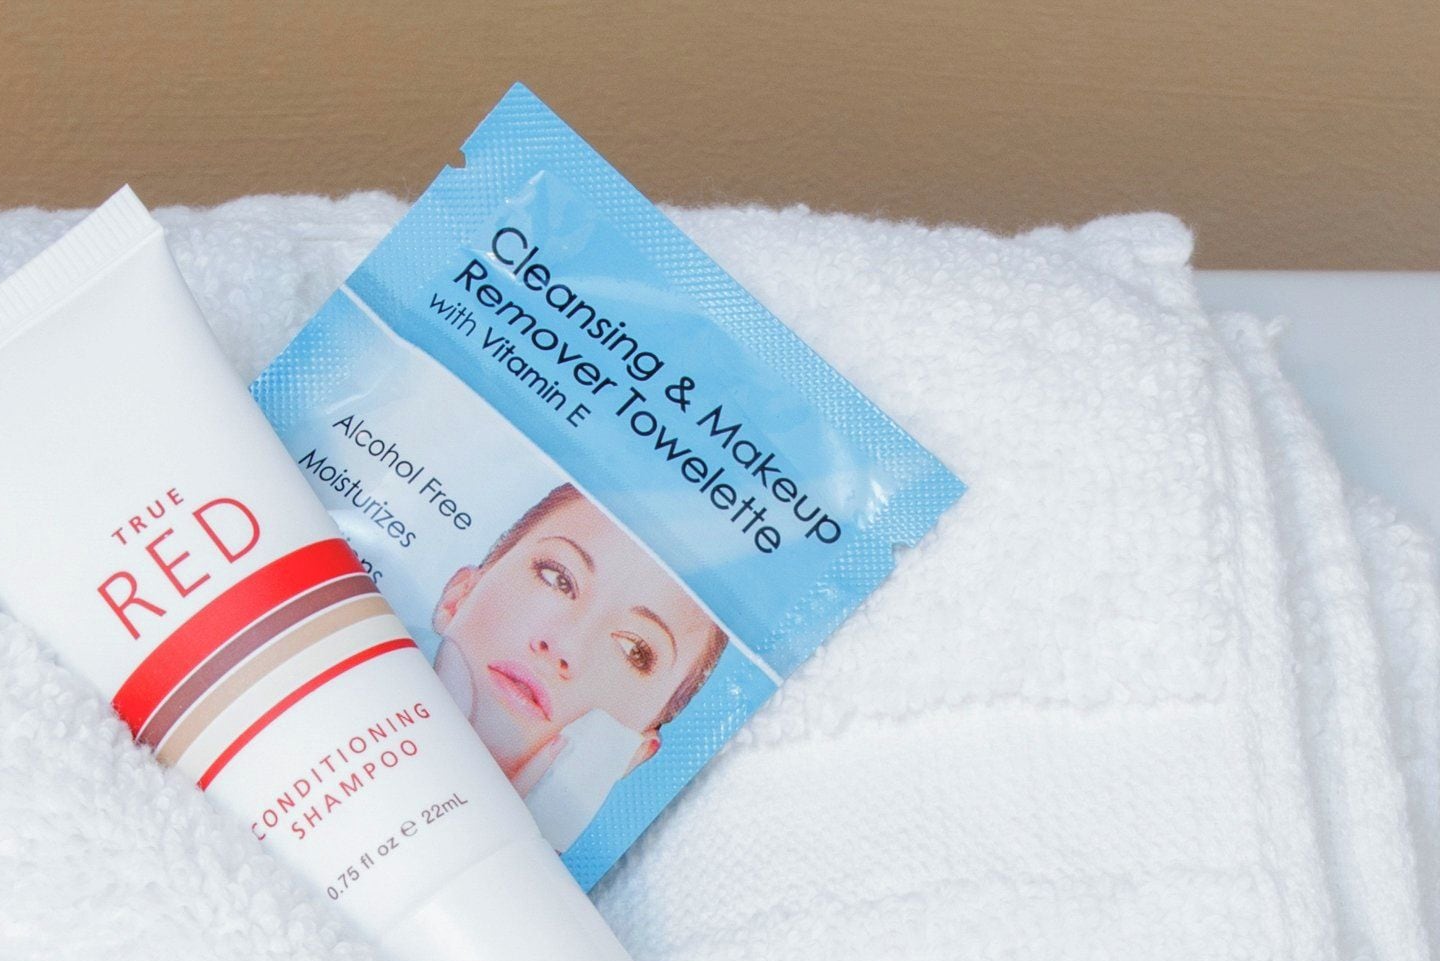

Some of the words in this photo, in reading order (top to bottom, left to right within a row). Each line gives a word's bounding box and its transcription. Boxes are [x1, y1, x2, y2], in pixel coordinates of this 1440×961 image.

[429, 292, 477, 337] with
[482, 326, 567, 411] Vitamin
[566, 403, 592, 428] E
[453, 258, 618, 395] Remover
[616, 386, 781, 554] Towelette
[491, 226, 665, 382] Cleansing
[664, 376, 695, 413] &
[696, 404, 842, 544] Makeup
[111, 487, 184, 546] TRUE
[298, 448, 417, 548] Moisturizes
[332, 414, 425, 484] Alcohol
[419, 477, 472, 530] Free
[96, 497, 261, 641] RED
[251, 702, 431, 841] CONDITIONING
[291, 739, 418, 840] SHAMPOO
[326, 866, 360, 901] 0.75
[360, 852, 375, 870] fl
[377, 836, 399, 857] oz
[421, 792, 469, 825] 22mL
